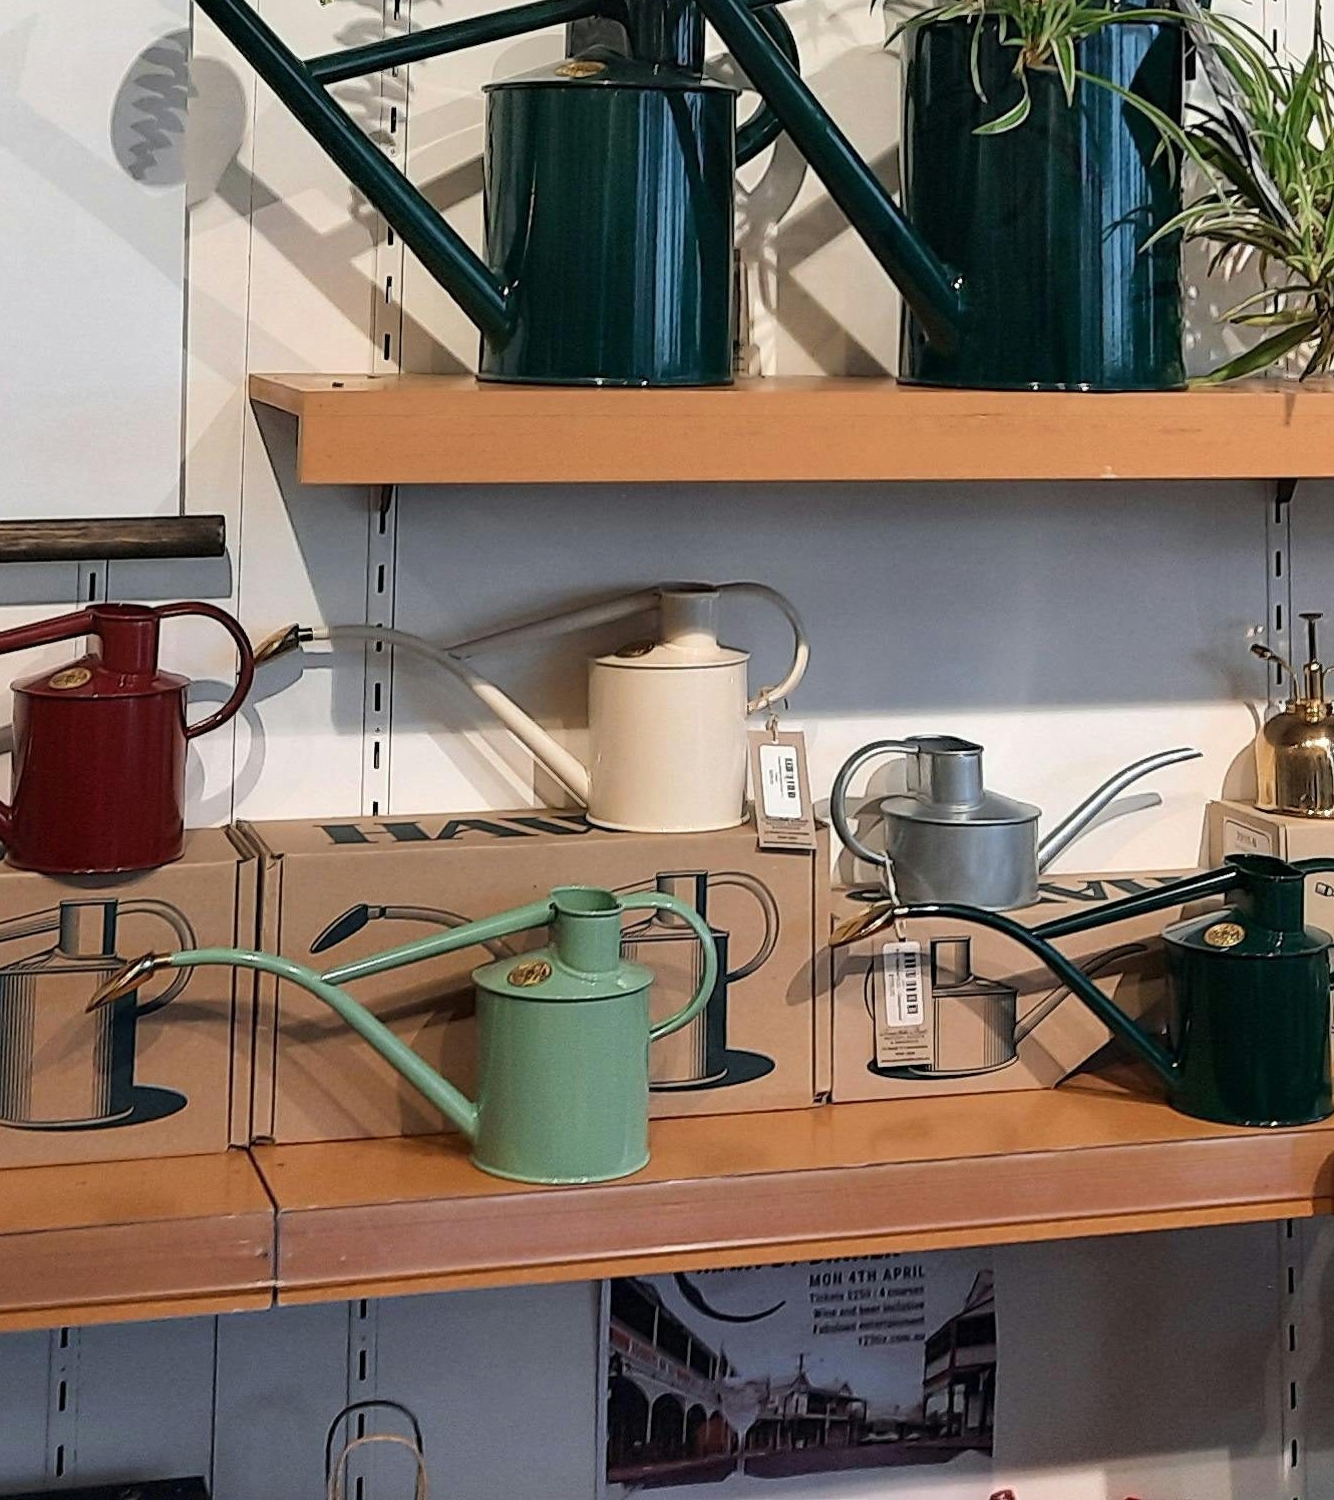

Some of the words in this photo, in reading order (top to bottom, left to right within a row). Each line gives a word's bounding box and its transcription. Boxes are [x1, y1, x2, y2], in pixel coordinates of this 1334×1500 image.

[809, 1271, 843, 1288] MON
[848, 1268, 877, 1284] 4TH
[882, 1265, 925, 1281] APRIL
